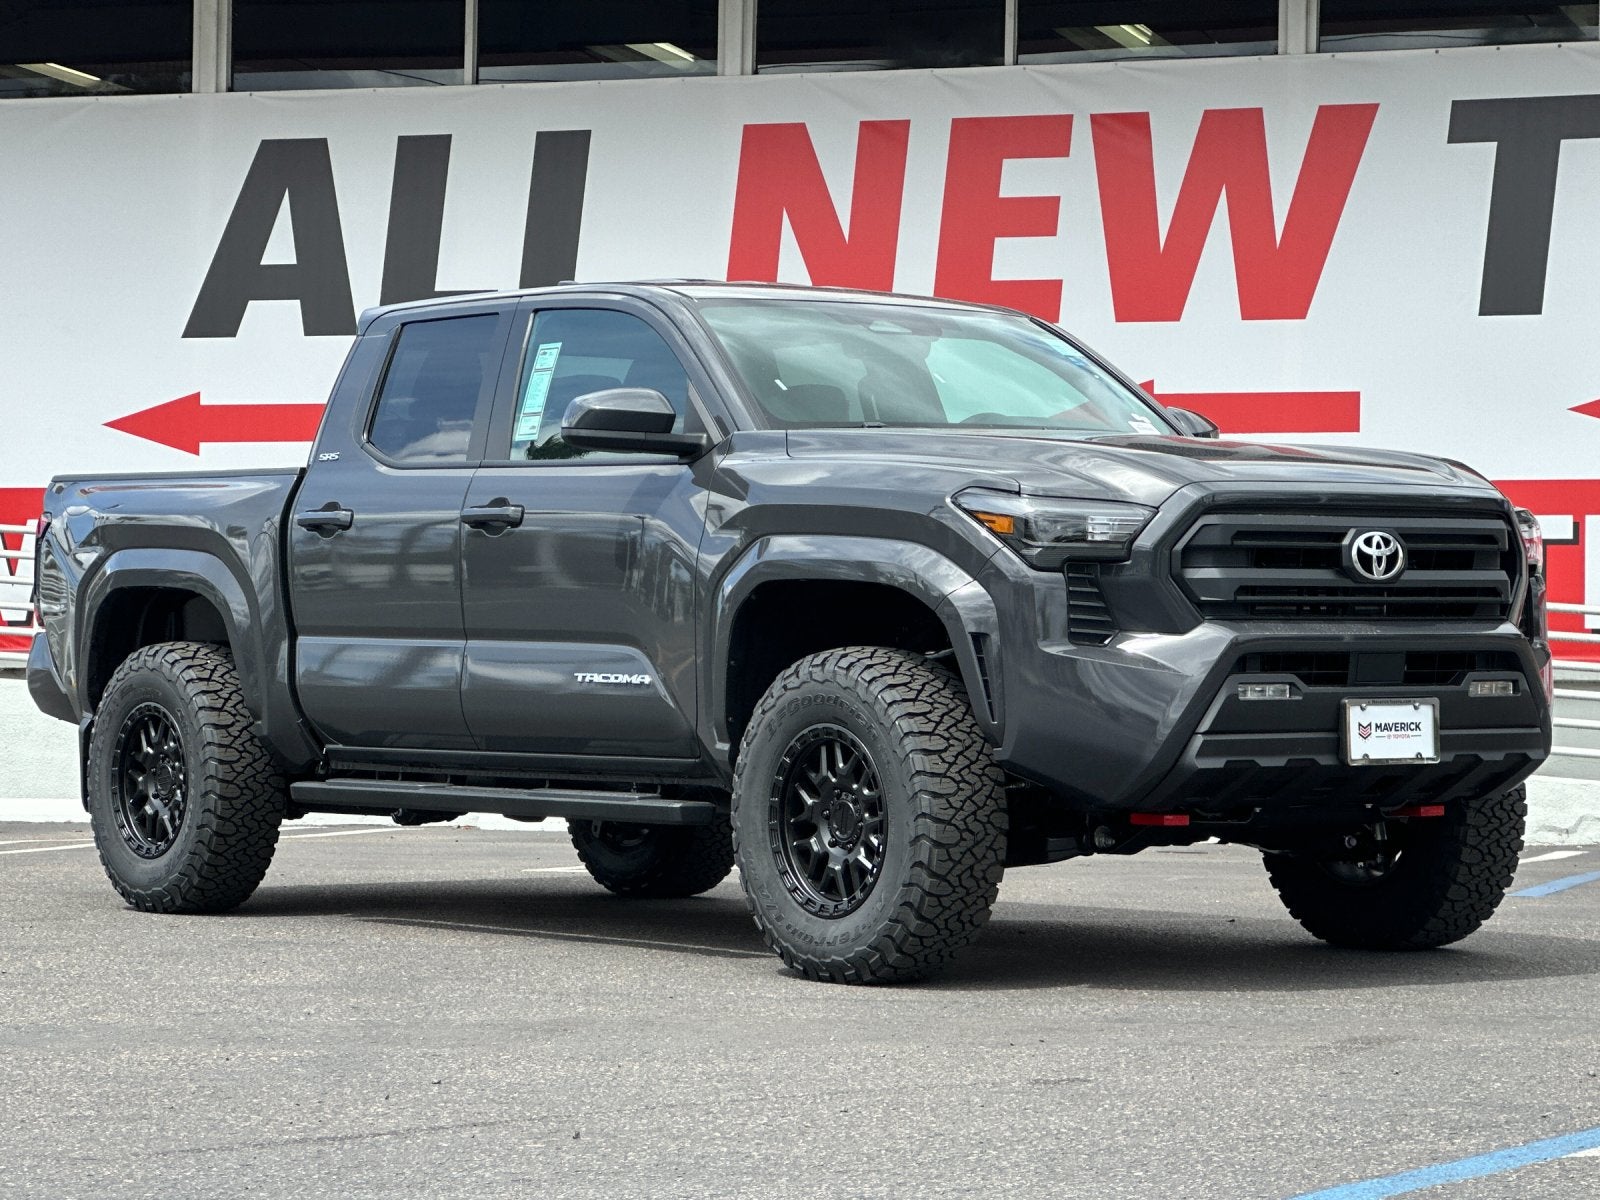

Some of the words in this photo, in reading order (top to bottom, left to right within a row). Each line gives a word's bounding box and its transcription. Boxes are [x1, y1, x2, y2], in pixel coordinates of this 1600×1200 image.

[726, 102, 1380, 323] NEW
[573, 672, 653, 685] TACOMA
[1374, 721, 1422, 733] MAVERICK
